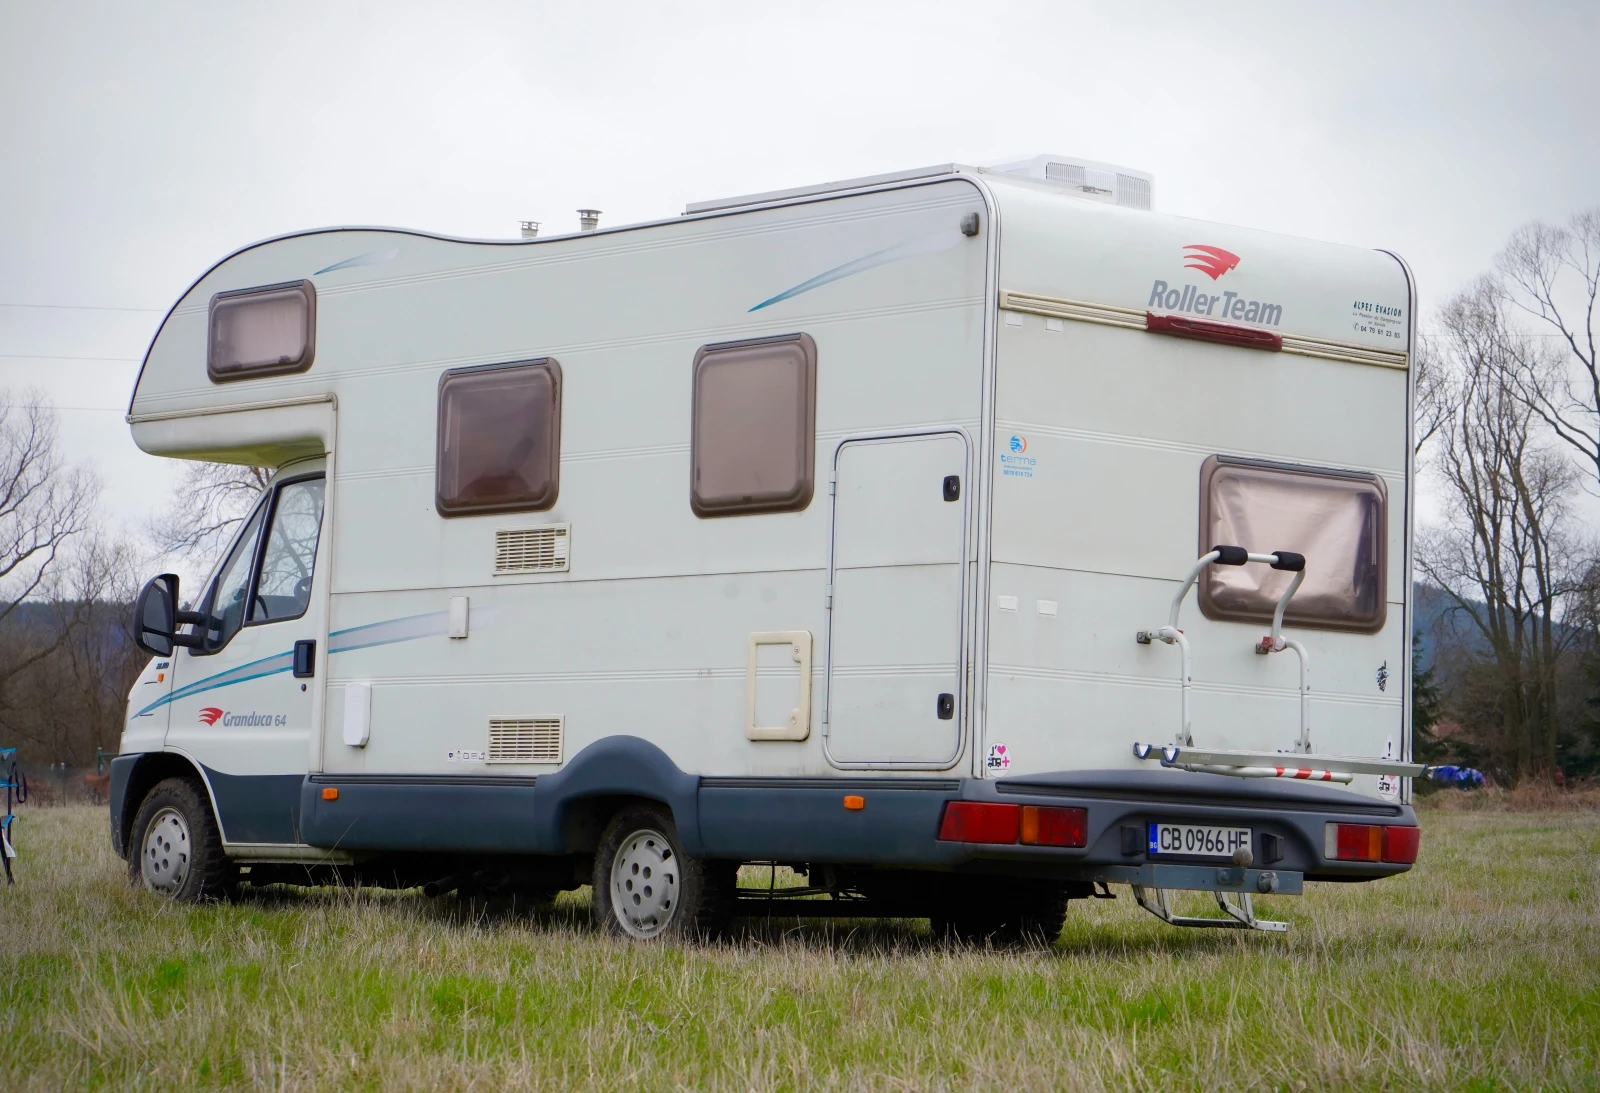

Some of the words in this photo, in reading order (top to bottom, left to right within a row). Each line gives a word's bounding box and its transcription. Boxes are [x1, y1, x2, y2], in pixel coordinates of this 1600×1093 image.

[1148, 280, 1220, 316] Roller
[1222, 291, 1283, 326] Team
[1353, 300, 1373, 312] ALPES
[1000, 454, 1037, 466] terma
[223, 710, 272, 727] Granduca
[274, 714, 287, 727] 64
[1160, 827, 1183, 851] CB
[1185, 828, 1225, 853] 0966
